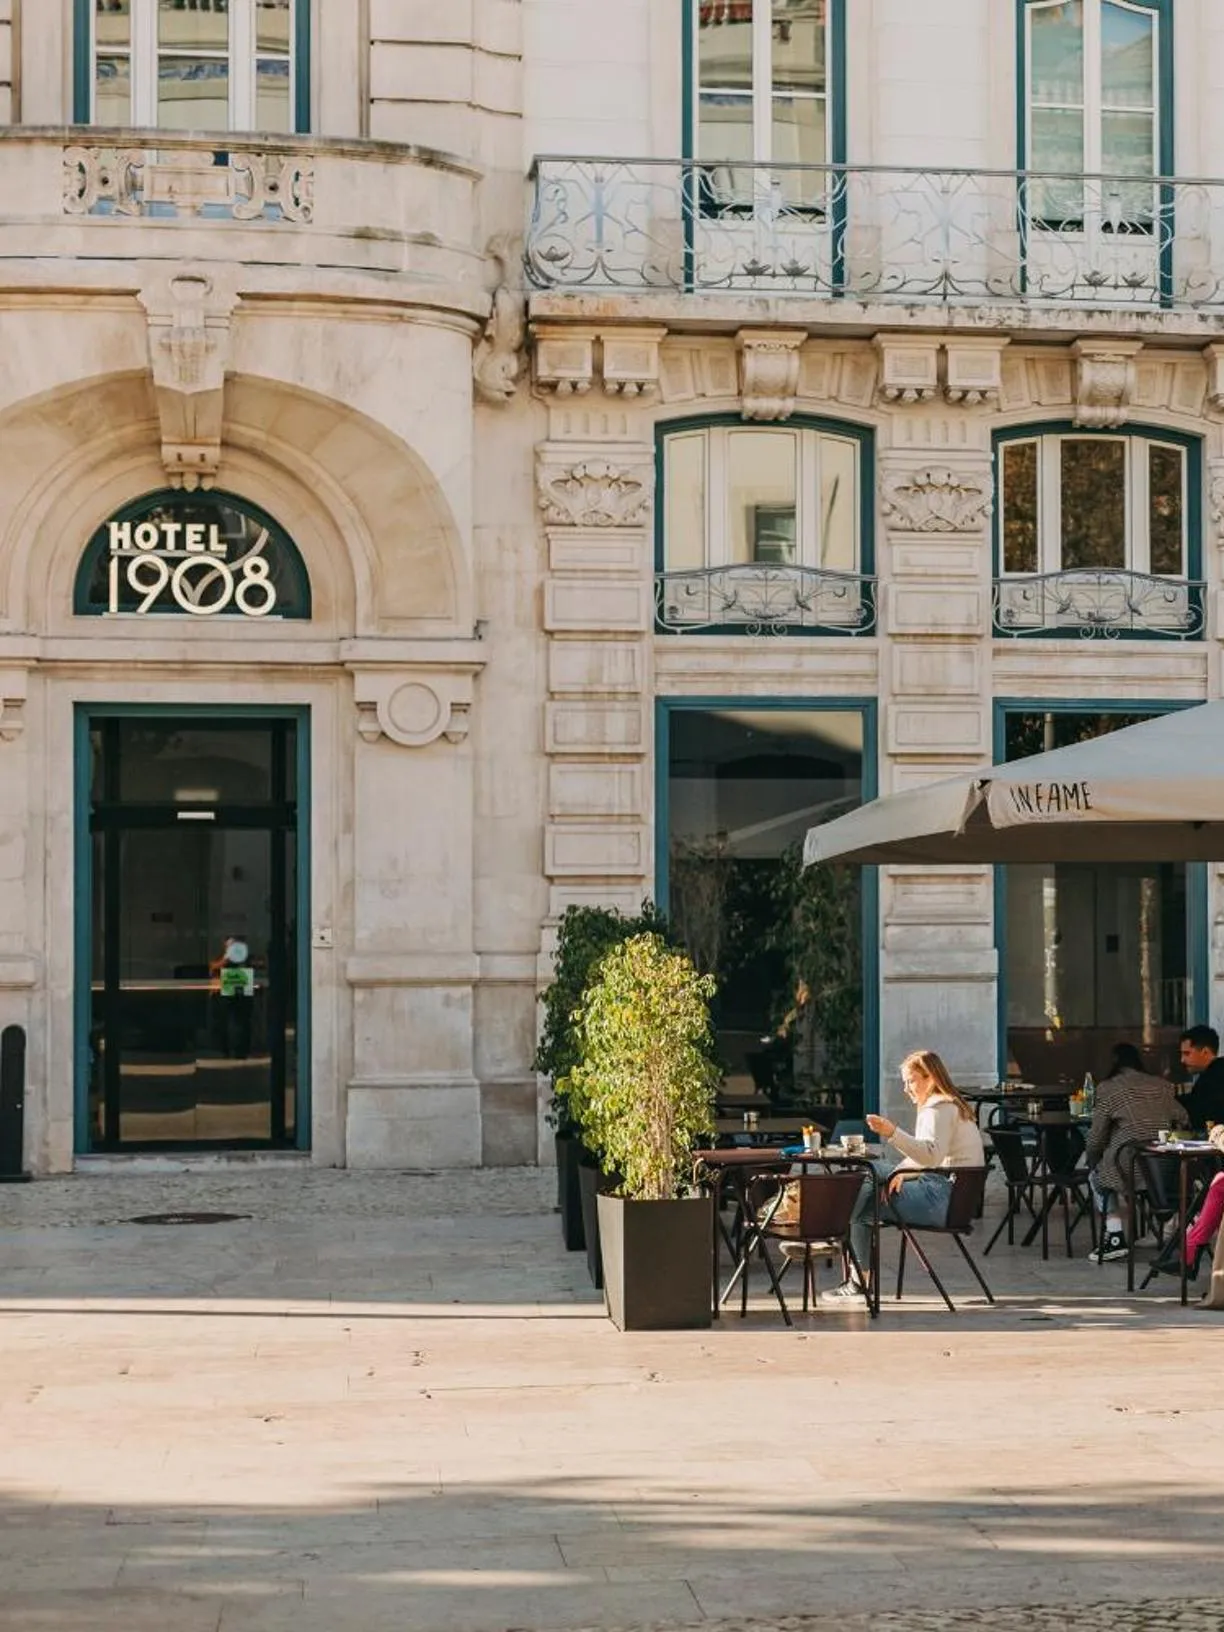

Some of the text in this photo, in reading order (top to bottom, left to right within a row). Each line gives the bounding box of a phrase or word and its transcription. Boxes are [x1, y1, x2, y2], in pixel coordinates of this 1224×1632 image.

[109, 521, 227, 551] HOTEL
[109, 554, 276, 616] 1908
[1010, 781, 1093, 813] INFAME
